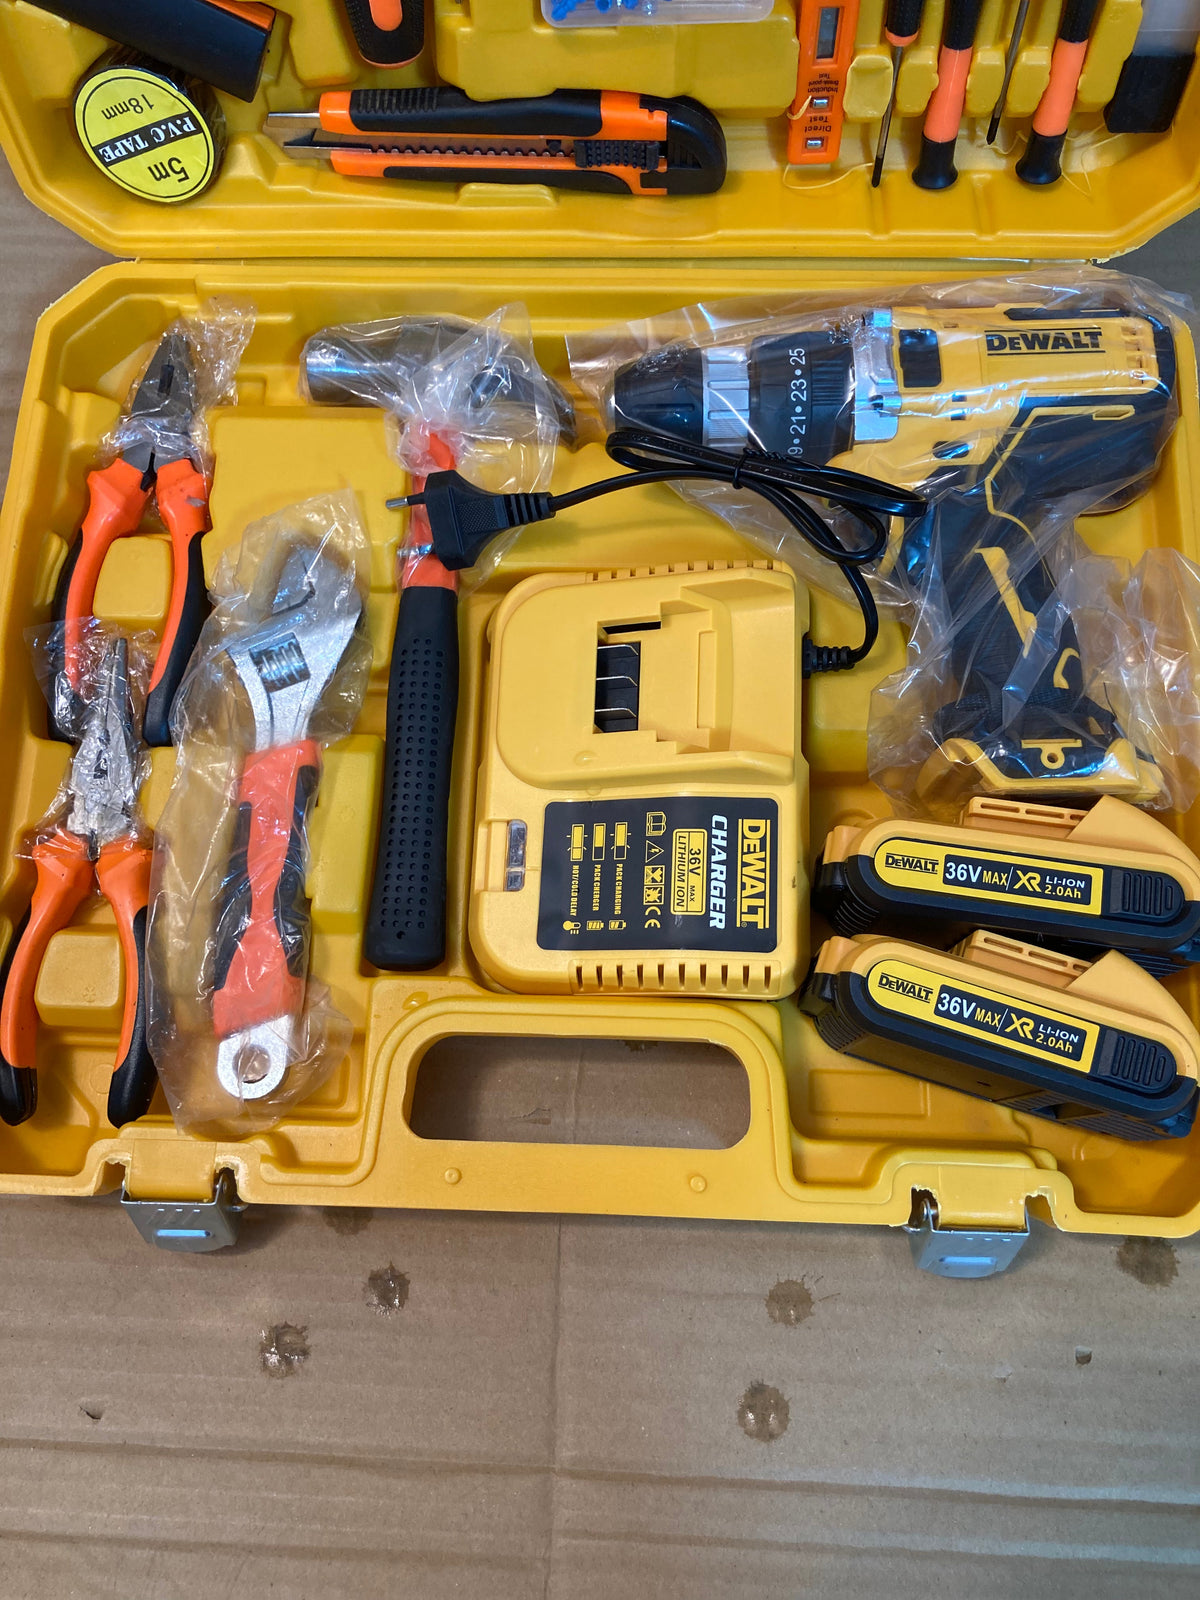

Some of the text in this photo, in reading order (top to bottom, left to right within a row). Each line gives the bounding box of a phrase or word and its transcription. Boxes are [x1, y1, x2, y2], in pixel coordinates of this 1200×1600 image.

[101, 94, 154, 120] 18mm
[98, 116, 197, 162] P.V.C TAPE
[804, 125, 831, 133] Direct
[147, 157, 190, 183] 5m
[789, 348, 806, 366] 25
[790, 379, 807, 401] 23
[789, 416, 806, 435] 21
[594, 864, 602, 881] PACK
[676, 835, 687, 908] LITHIUM ION
[689, 848, 701, 876] 36V
[710, 815, 728, 930] CHARGER
[945, 861, 1042, 892] 36V MAX XR
[1045, 875, 1086, 889] LI-ION
[614, 863, 624, 915] PACK CHARGING
[1044, 885, 1082, 899] 2.0Ah
[569, 897, 578, 917] DELAY
[937, 993, 1035, 1040] 36V MAX XR
[1035, 1032, 1074, 1053] 2.0Ah
[1038, 1023, 1080, 1044] LI-ION
